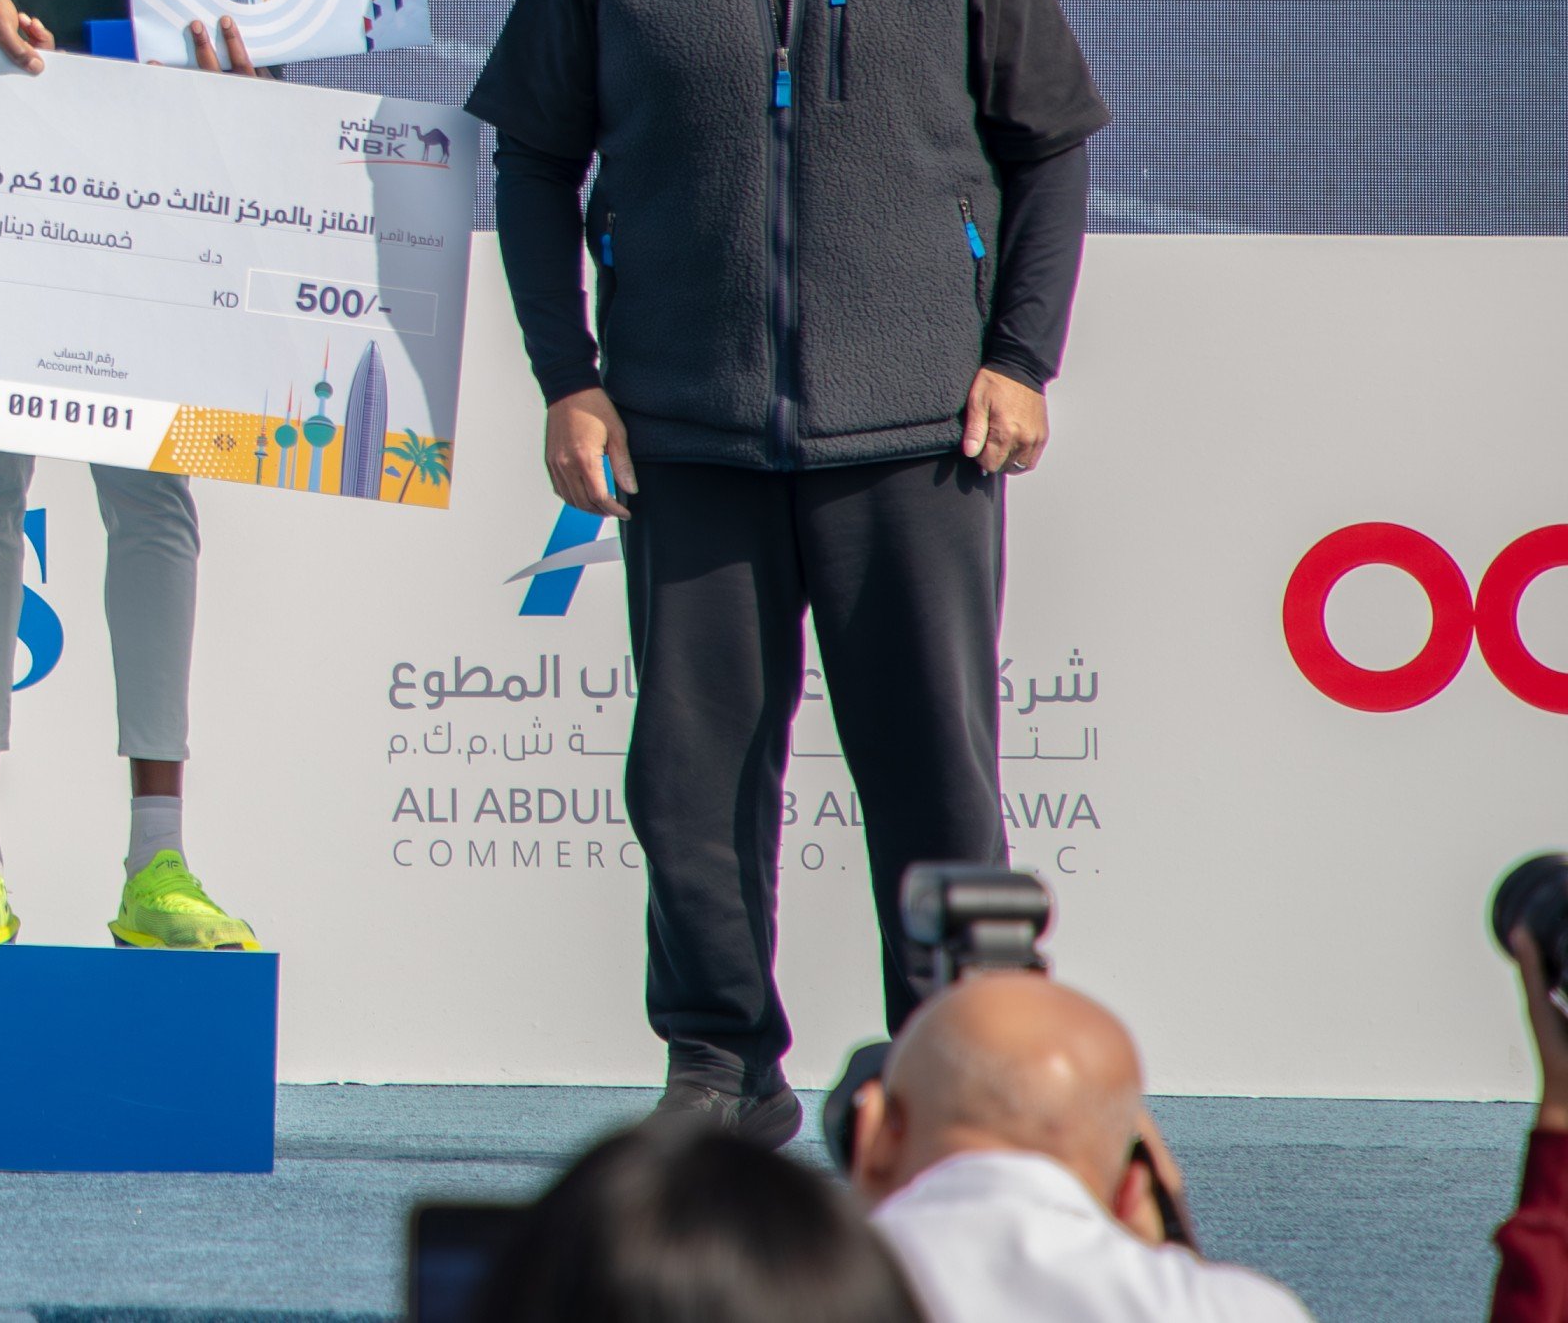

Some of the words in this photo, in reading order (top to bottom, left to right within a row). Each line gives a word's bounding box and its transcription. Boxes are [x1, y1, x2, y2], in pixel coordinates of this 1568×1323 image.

[340, 117, 409, 141] الوطني
[338, 136, 406, 159] NBK
[9, 171, 42, 193] كم
[49, 174, 77, 195] 10
[83, 177, 120, 200] فئة
[126, 190, 161, 210] من
[167, 188, 230, 216] الثالث
[235, 197, 313, 232] بالمركز
[317, 209, 376, 235] الفائز
[40, 219, 133, 250] خمسمائة
[212, 290, 240, 309] KD
[295, 282, 392, 319] 500/-
[37, 358, 83, 376] Account
[84, 364, 130, 380] Number
[8, 392, 134, 431] 0010101
[389, 654, 561, 710] المطوع
[392, 788, 458, 823] ALI
